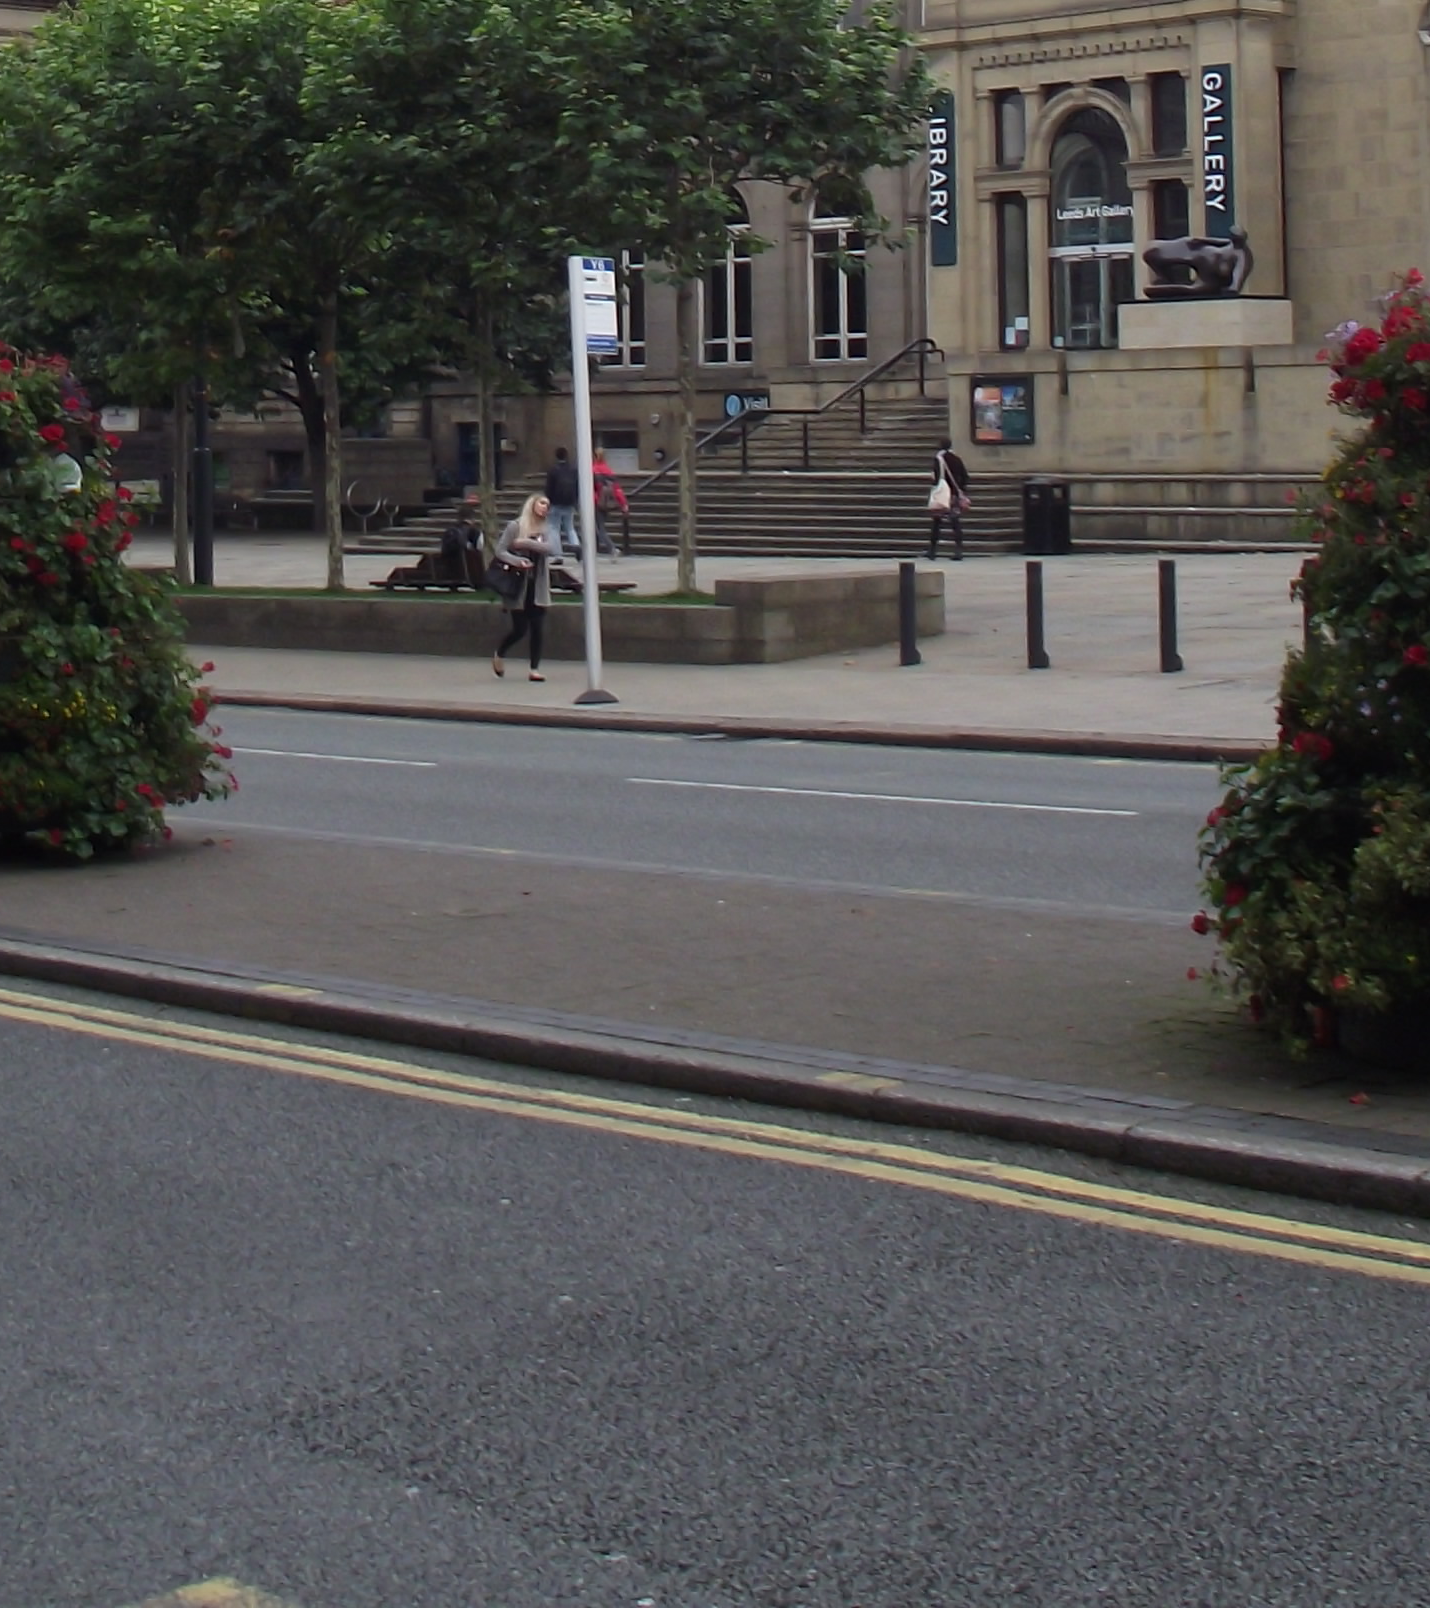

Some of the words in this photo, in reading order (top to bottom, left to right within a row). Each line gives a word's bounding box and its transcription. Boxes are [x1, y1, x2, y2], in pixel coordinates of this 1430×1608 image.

[929, 108, 949, 226] IBRARY
[1202, 72, 1226, 212] GALLERY
[590, 259, 605, 271] Y6
